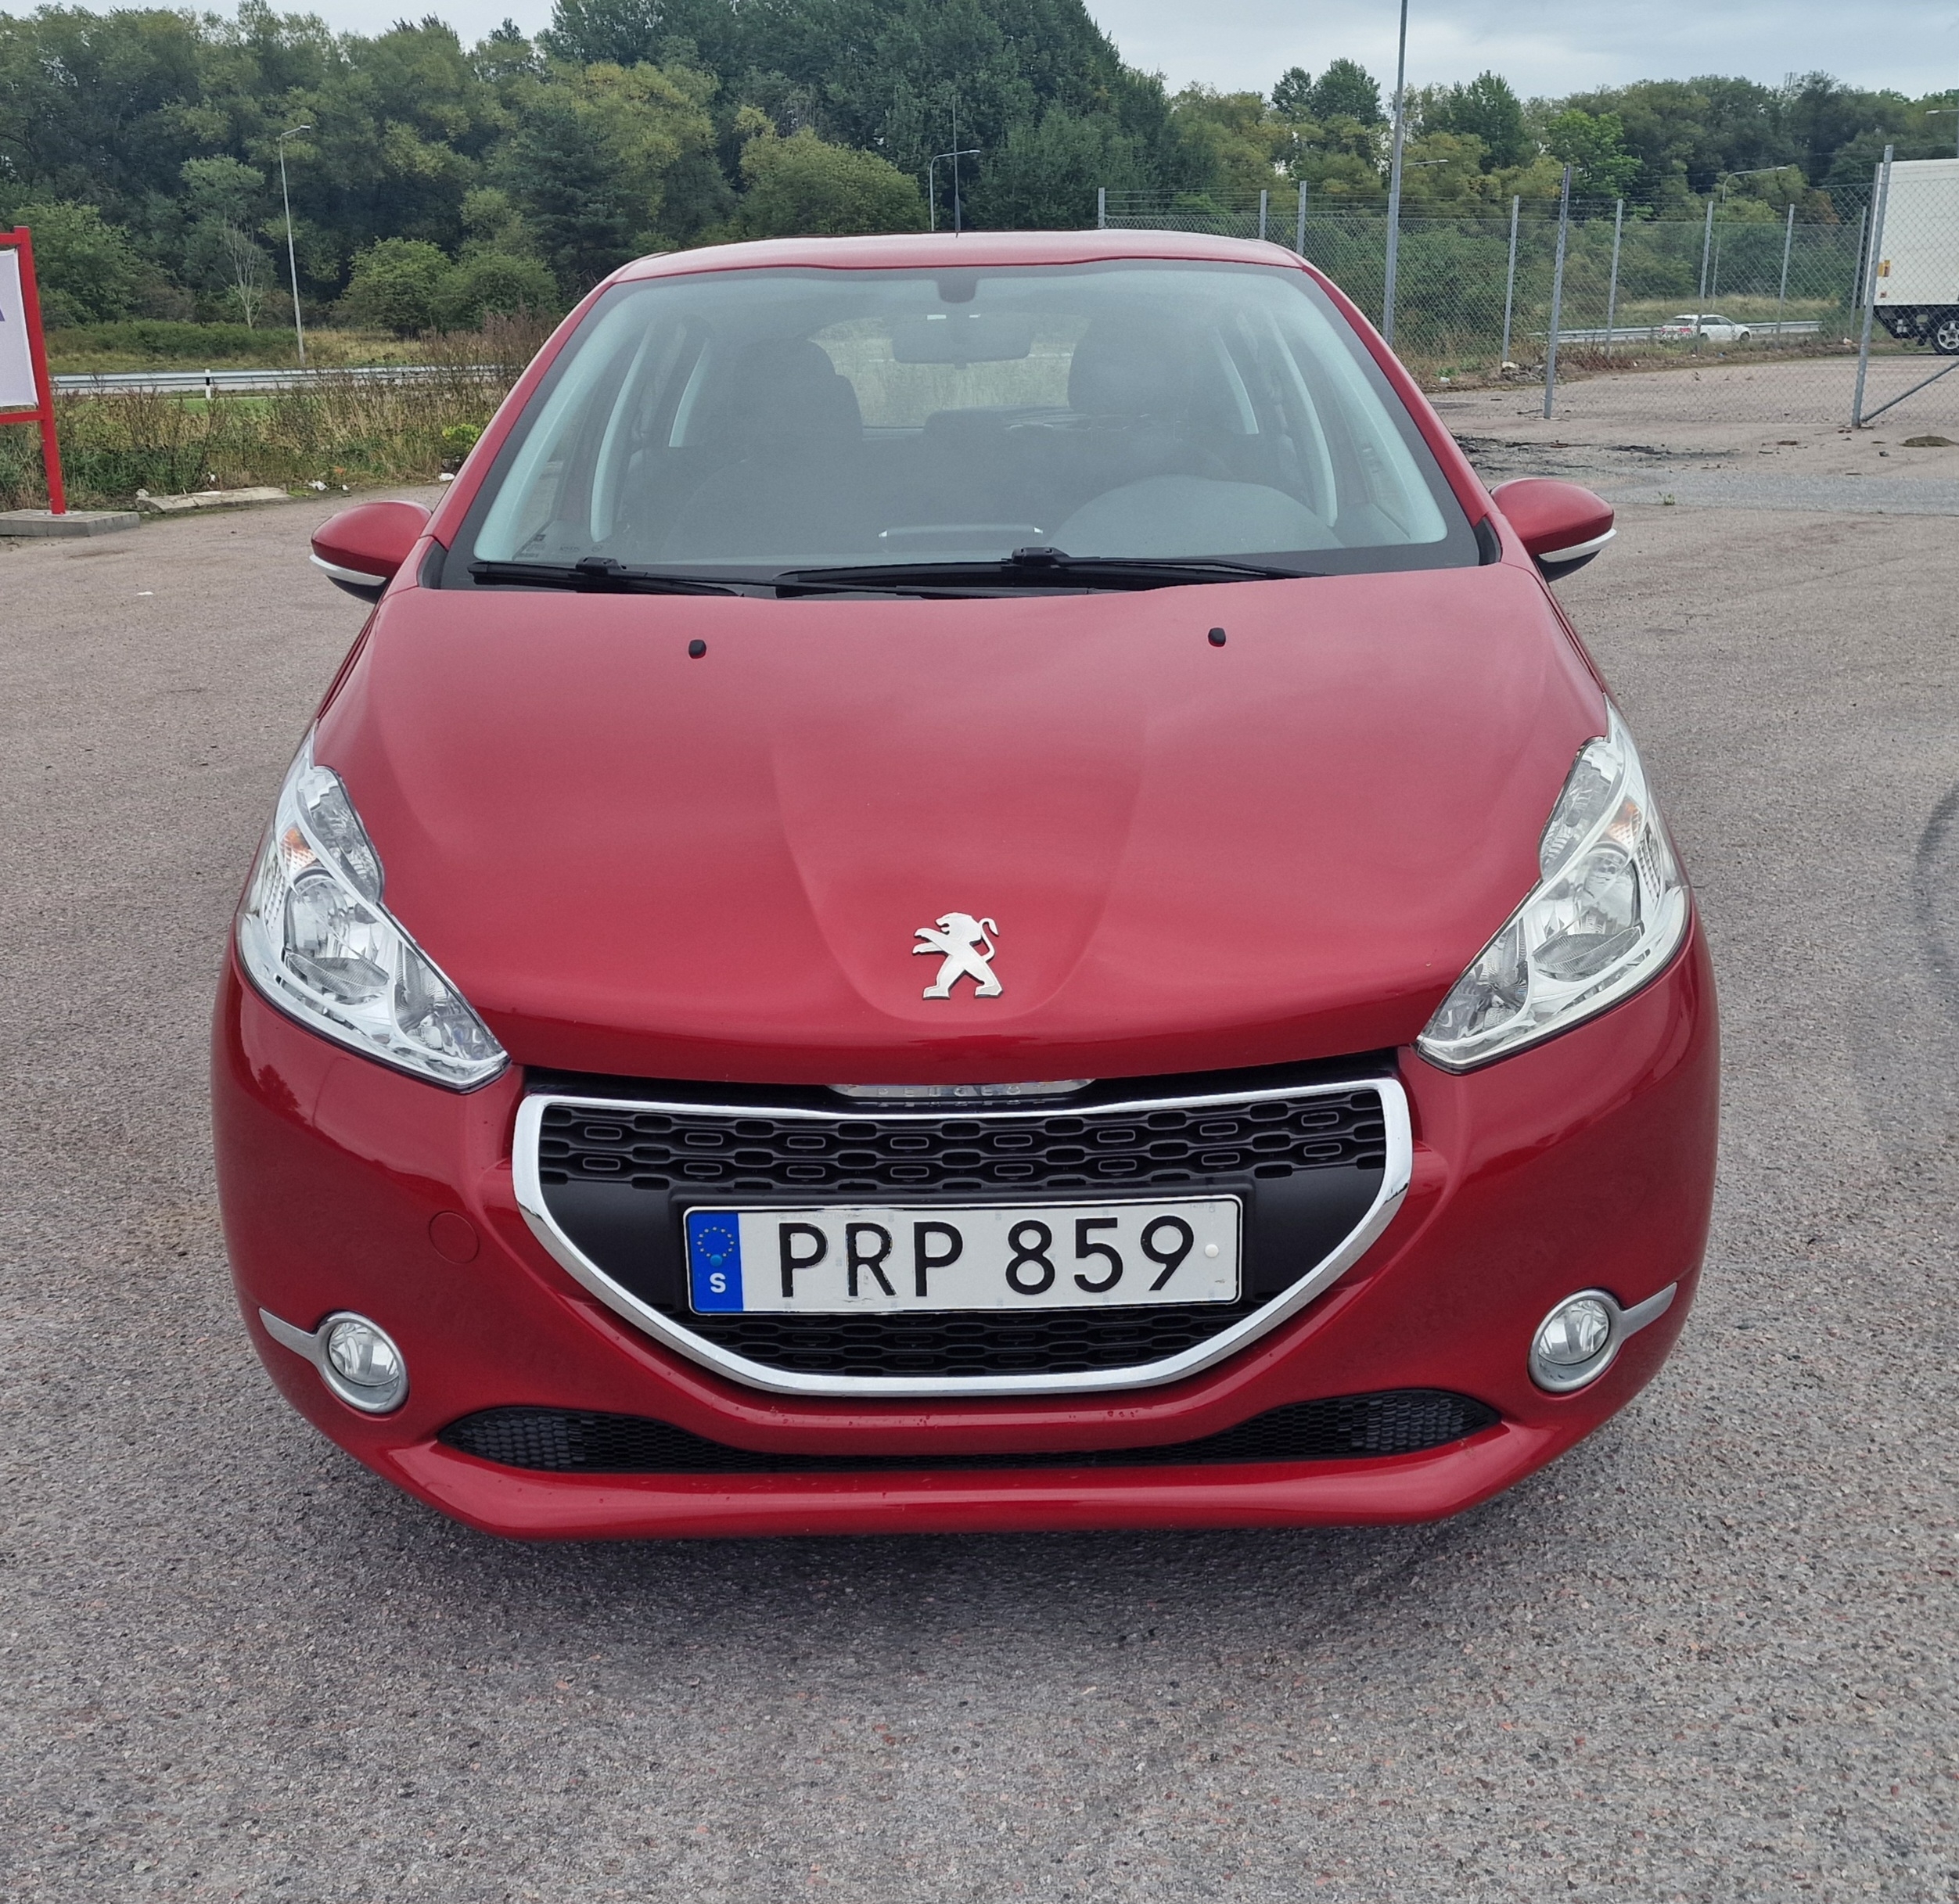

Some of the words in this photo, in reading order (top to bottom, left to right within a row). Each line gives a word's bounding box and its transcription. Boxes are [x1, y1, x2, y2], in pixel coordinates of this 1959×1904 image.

[877, 1084, 1044, 1097] PEUGEOT
[778, 1221, 963, 1298] PRP
[1005, 1215, 1194, 1295] 859
[710, 1273, 726, 1293] S
